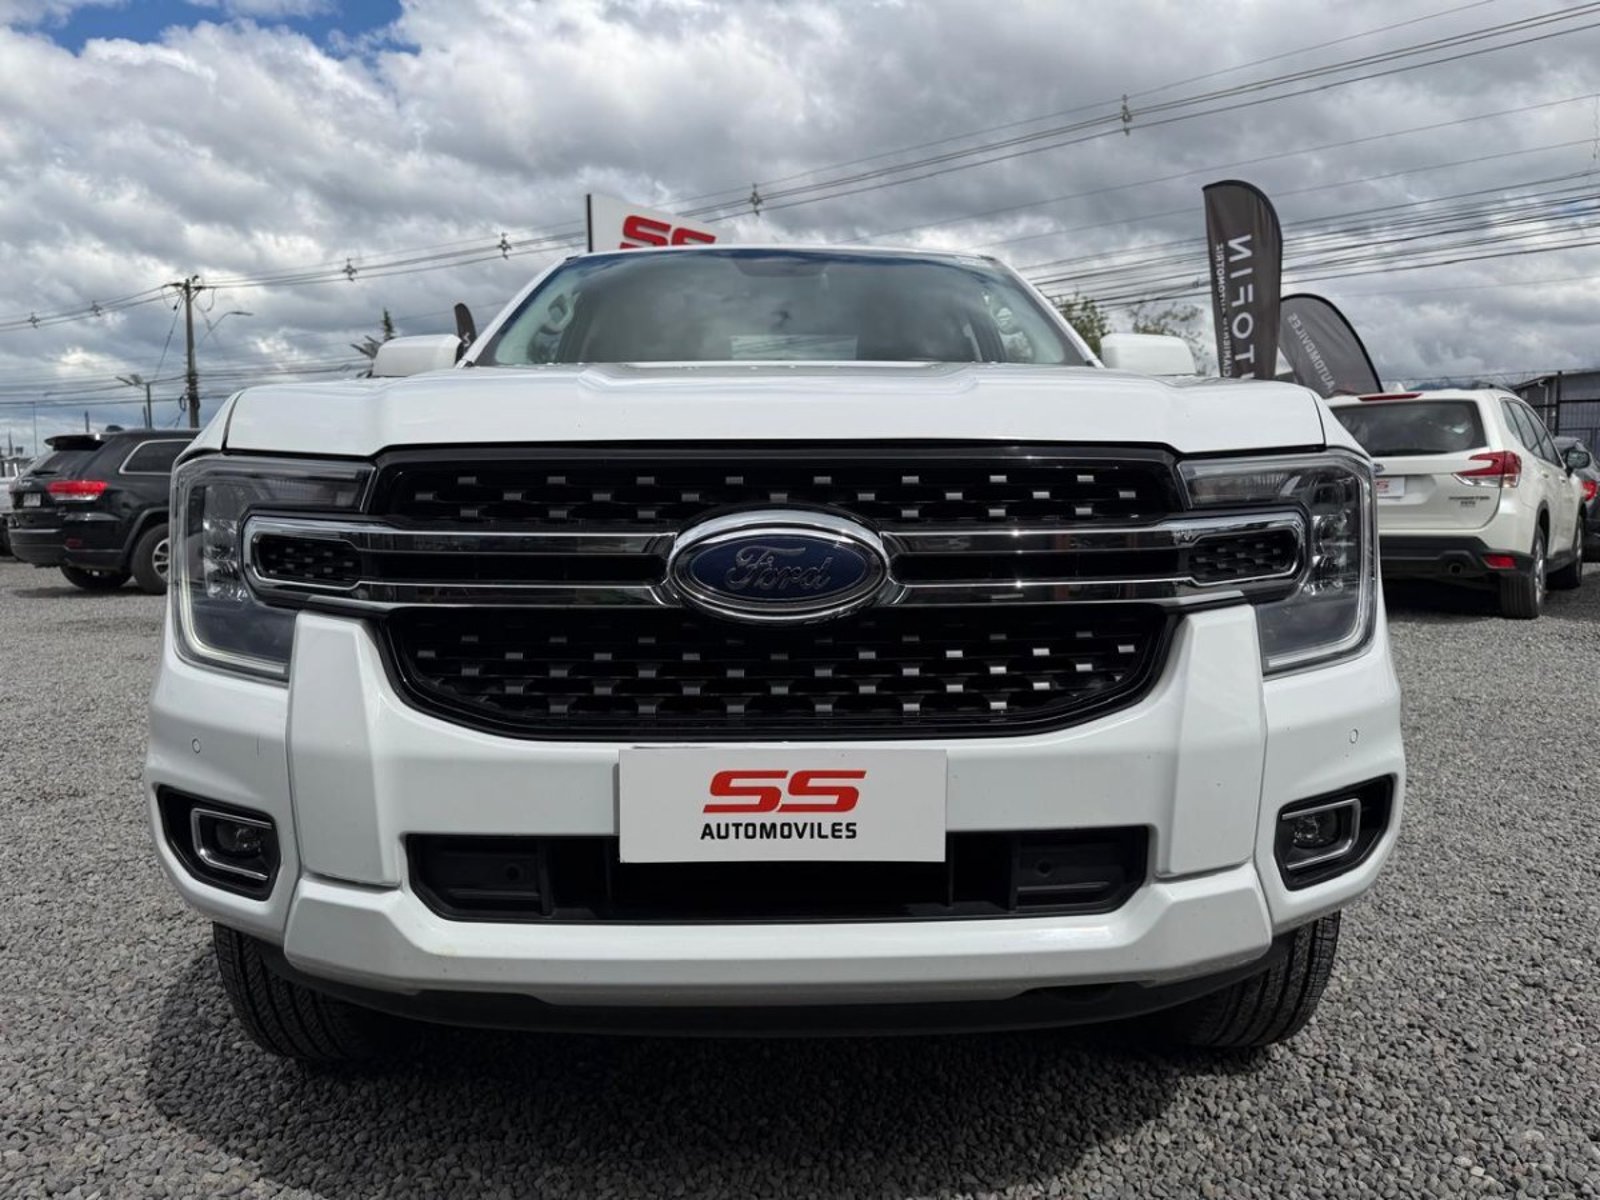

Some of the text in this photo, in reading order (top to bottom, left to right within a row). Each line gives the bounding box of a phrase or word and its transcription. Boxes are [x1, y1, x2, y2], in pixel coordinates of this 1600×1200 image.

[724, 544, 834, 590] Ford
[703, 769, 867, 814] SS
[700, 821, 858, 841] AUTOMOVILES
